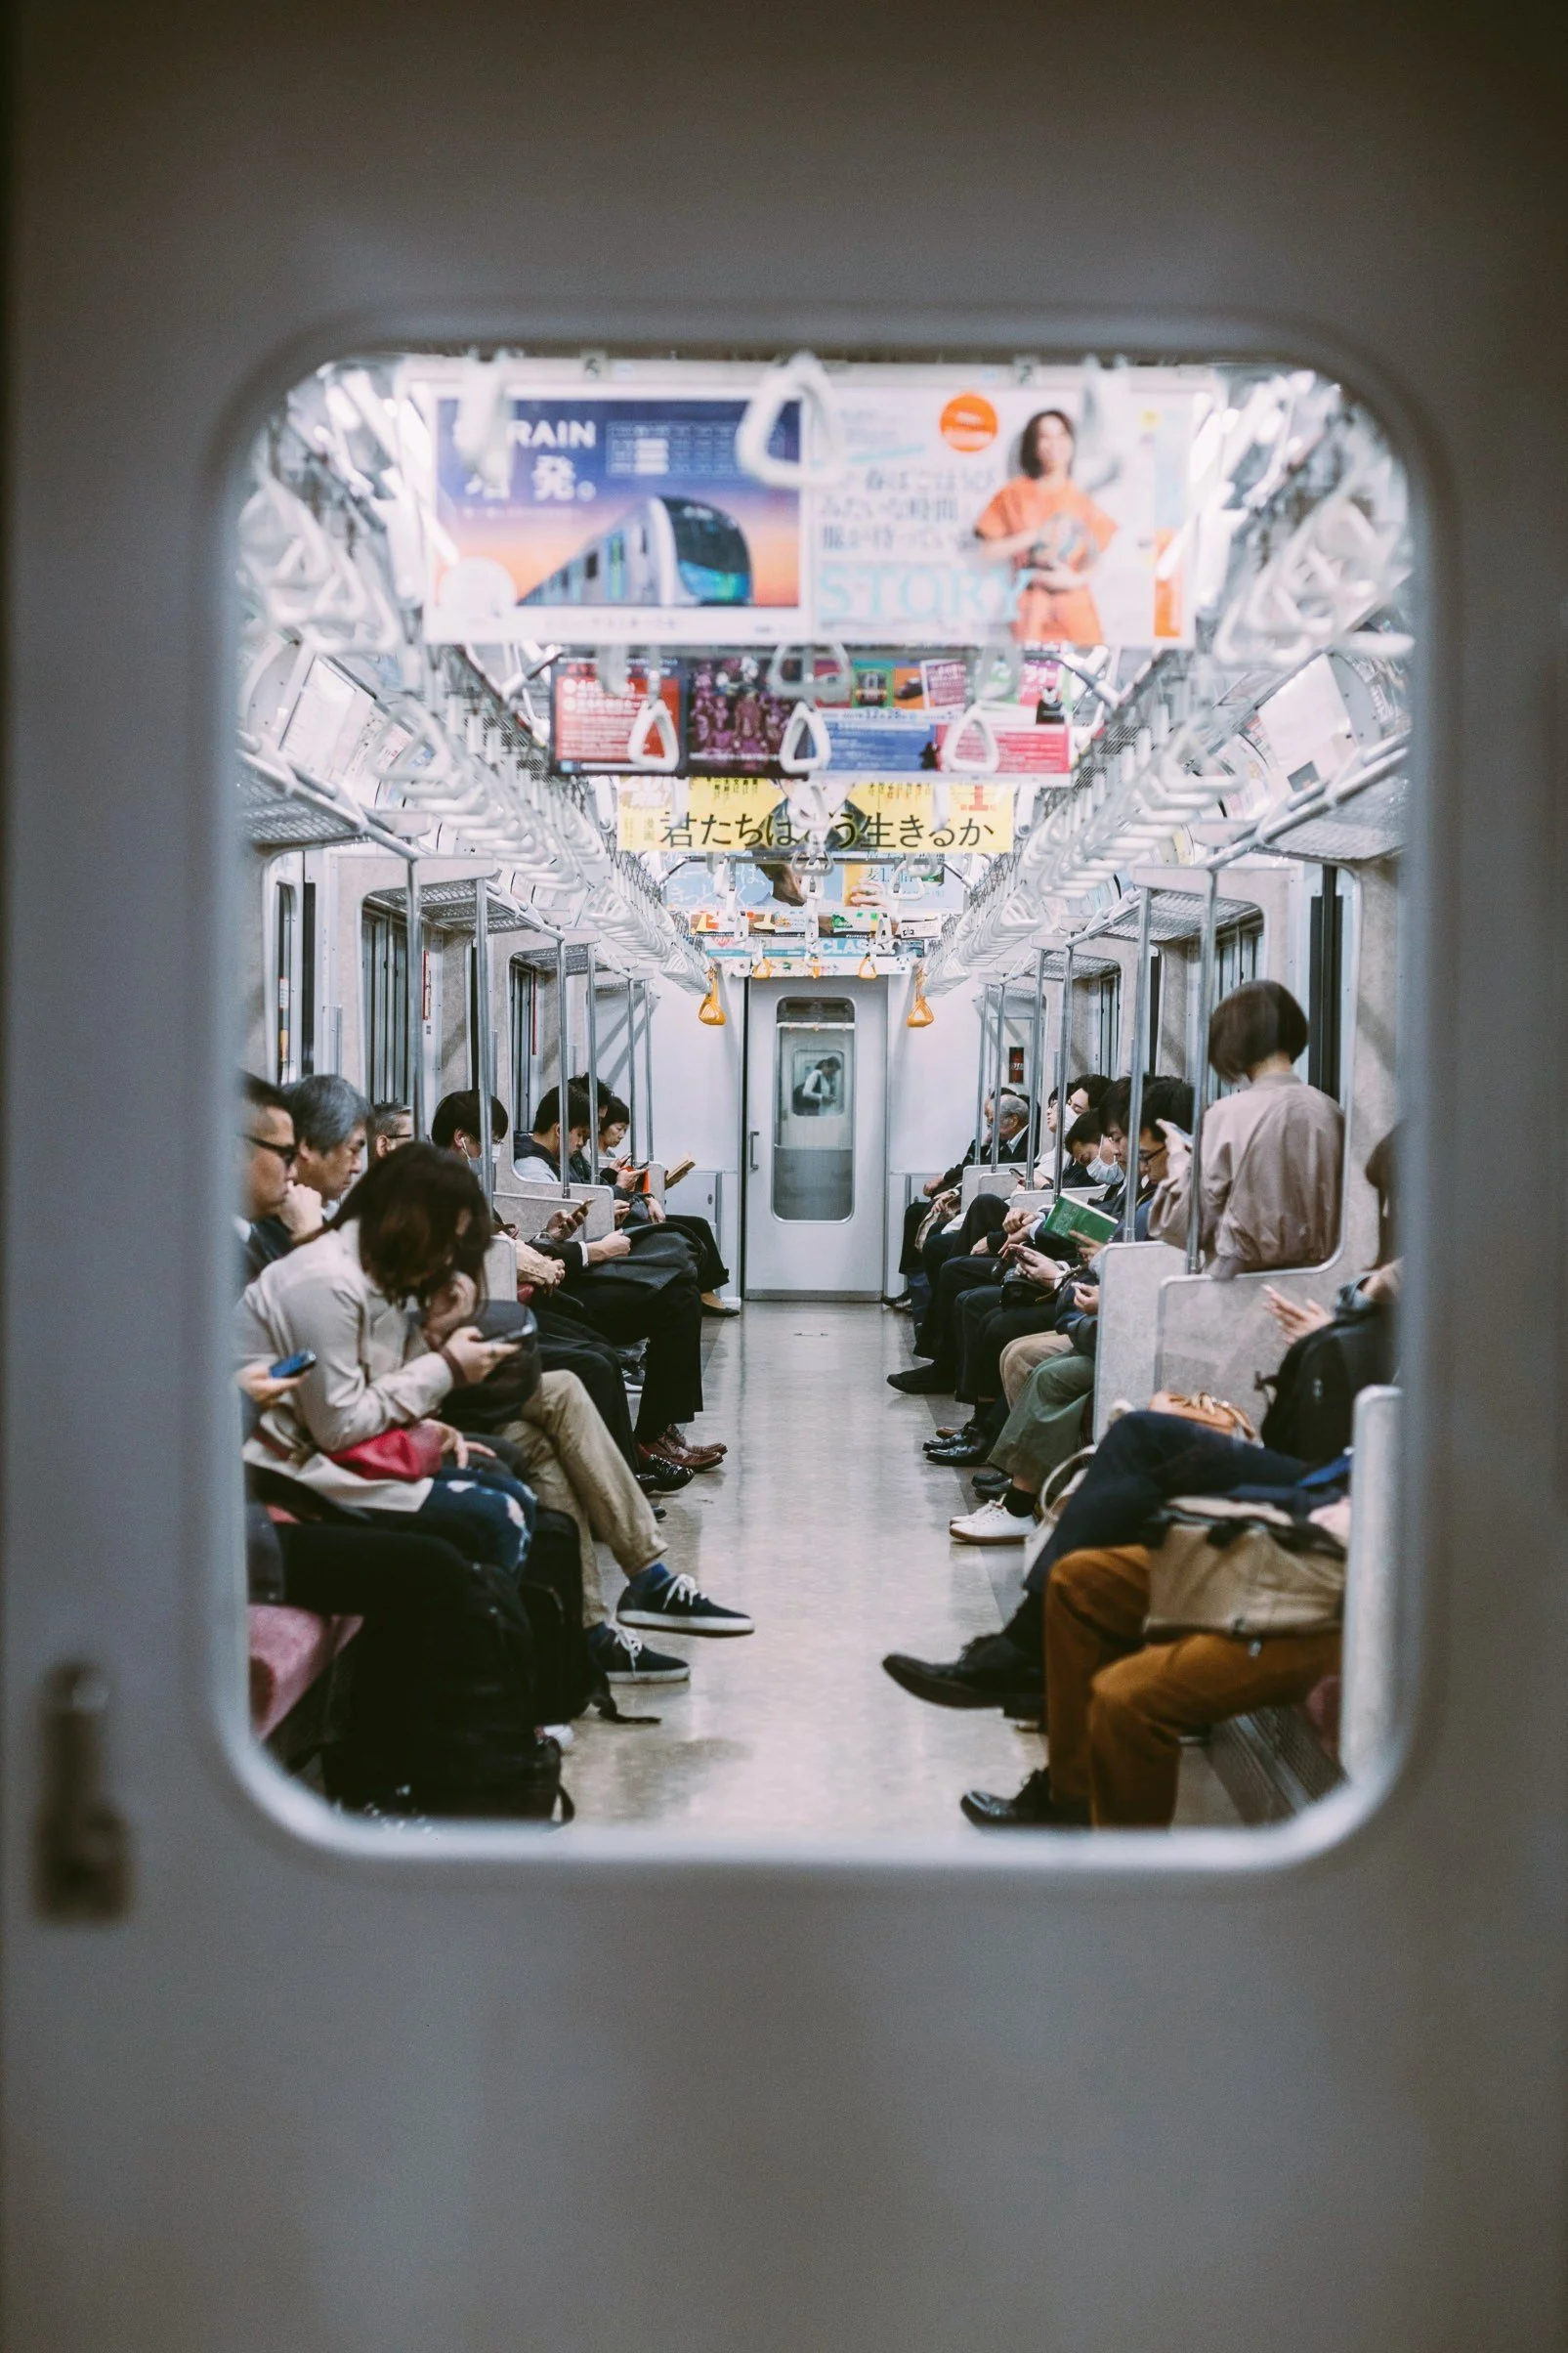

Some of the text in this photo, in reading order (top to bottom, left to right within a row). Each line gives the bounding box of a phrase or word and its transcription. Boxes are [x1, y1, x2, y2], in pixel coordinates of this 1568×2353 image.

[502, 420, 598, 449] RAIN
[818, 564, 1033, 620] STORY
[660, 811, 995, 849] 君たちはう生きるか
